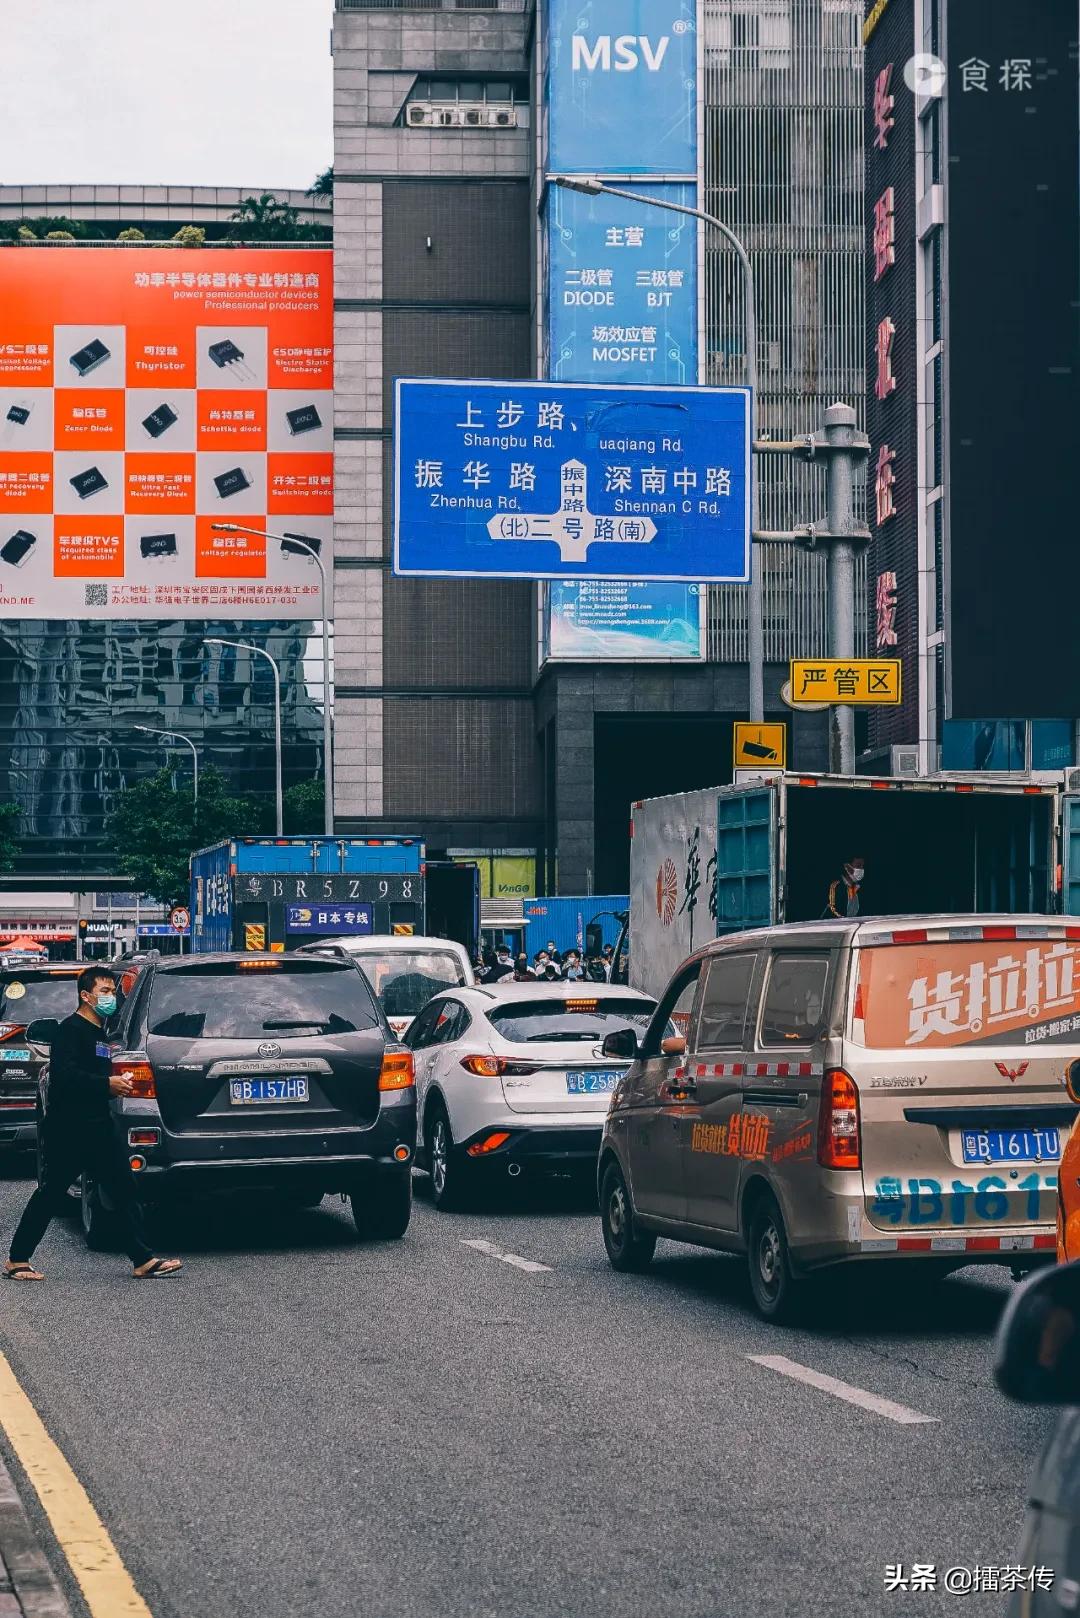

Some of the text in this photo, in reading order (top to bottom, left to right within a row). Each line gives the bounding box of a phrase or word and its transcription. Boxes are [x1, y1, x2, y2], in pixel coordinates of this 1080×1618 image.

[572, 35, 670, 71] MSV
[605, 226, 644, 247] 主营
[134, 272, 319, 288] 功率半导体器件专业制造商
[564, 269, 684, 287] 二极管 三极管
[173, 290, 319, 300] power semiconductor devices
[564, 291, 672, 307] DIODE BJT
[204, 300, 319, 312] Professional producers
[592, 326, 656, 343] 场效应管
[144, 346, 178, 356] 可控硅
[592, 348, 658, 362] MOSFET
[136, 361, 185, 370] Thyristor
[464, 434, 556, 448] Shangbu Rd.
[600, 438, 684, 453] uaqiang Rd.
[415, 460, 536, 490] 振华路
[604, 466, 732, 496] 深南中路
[562, 468, 584, 513] 振中路
[430, 494, 521, 509] Zhenhua Rd.
[614, 499, 721, 514] Shennan C Rd.
[801, 668, 892, 695] 严管区
[318, 911, 369, 925] 日本专线
[86, 924, 123, 932] HUAWEI
[906, 942, 1075, 1045] 货拉拉
[224, 1062, 318, 1071] HIGHLANDER
